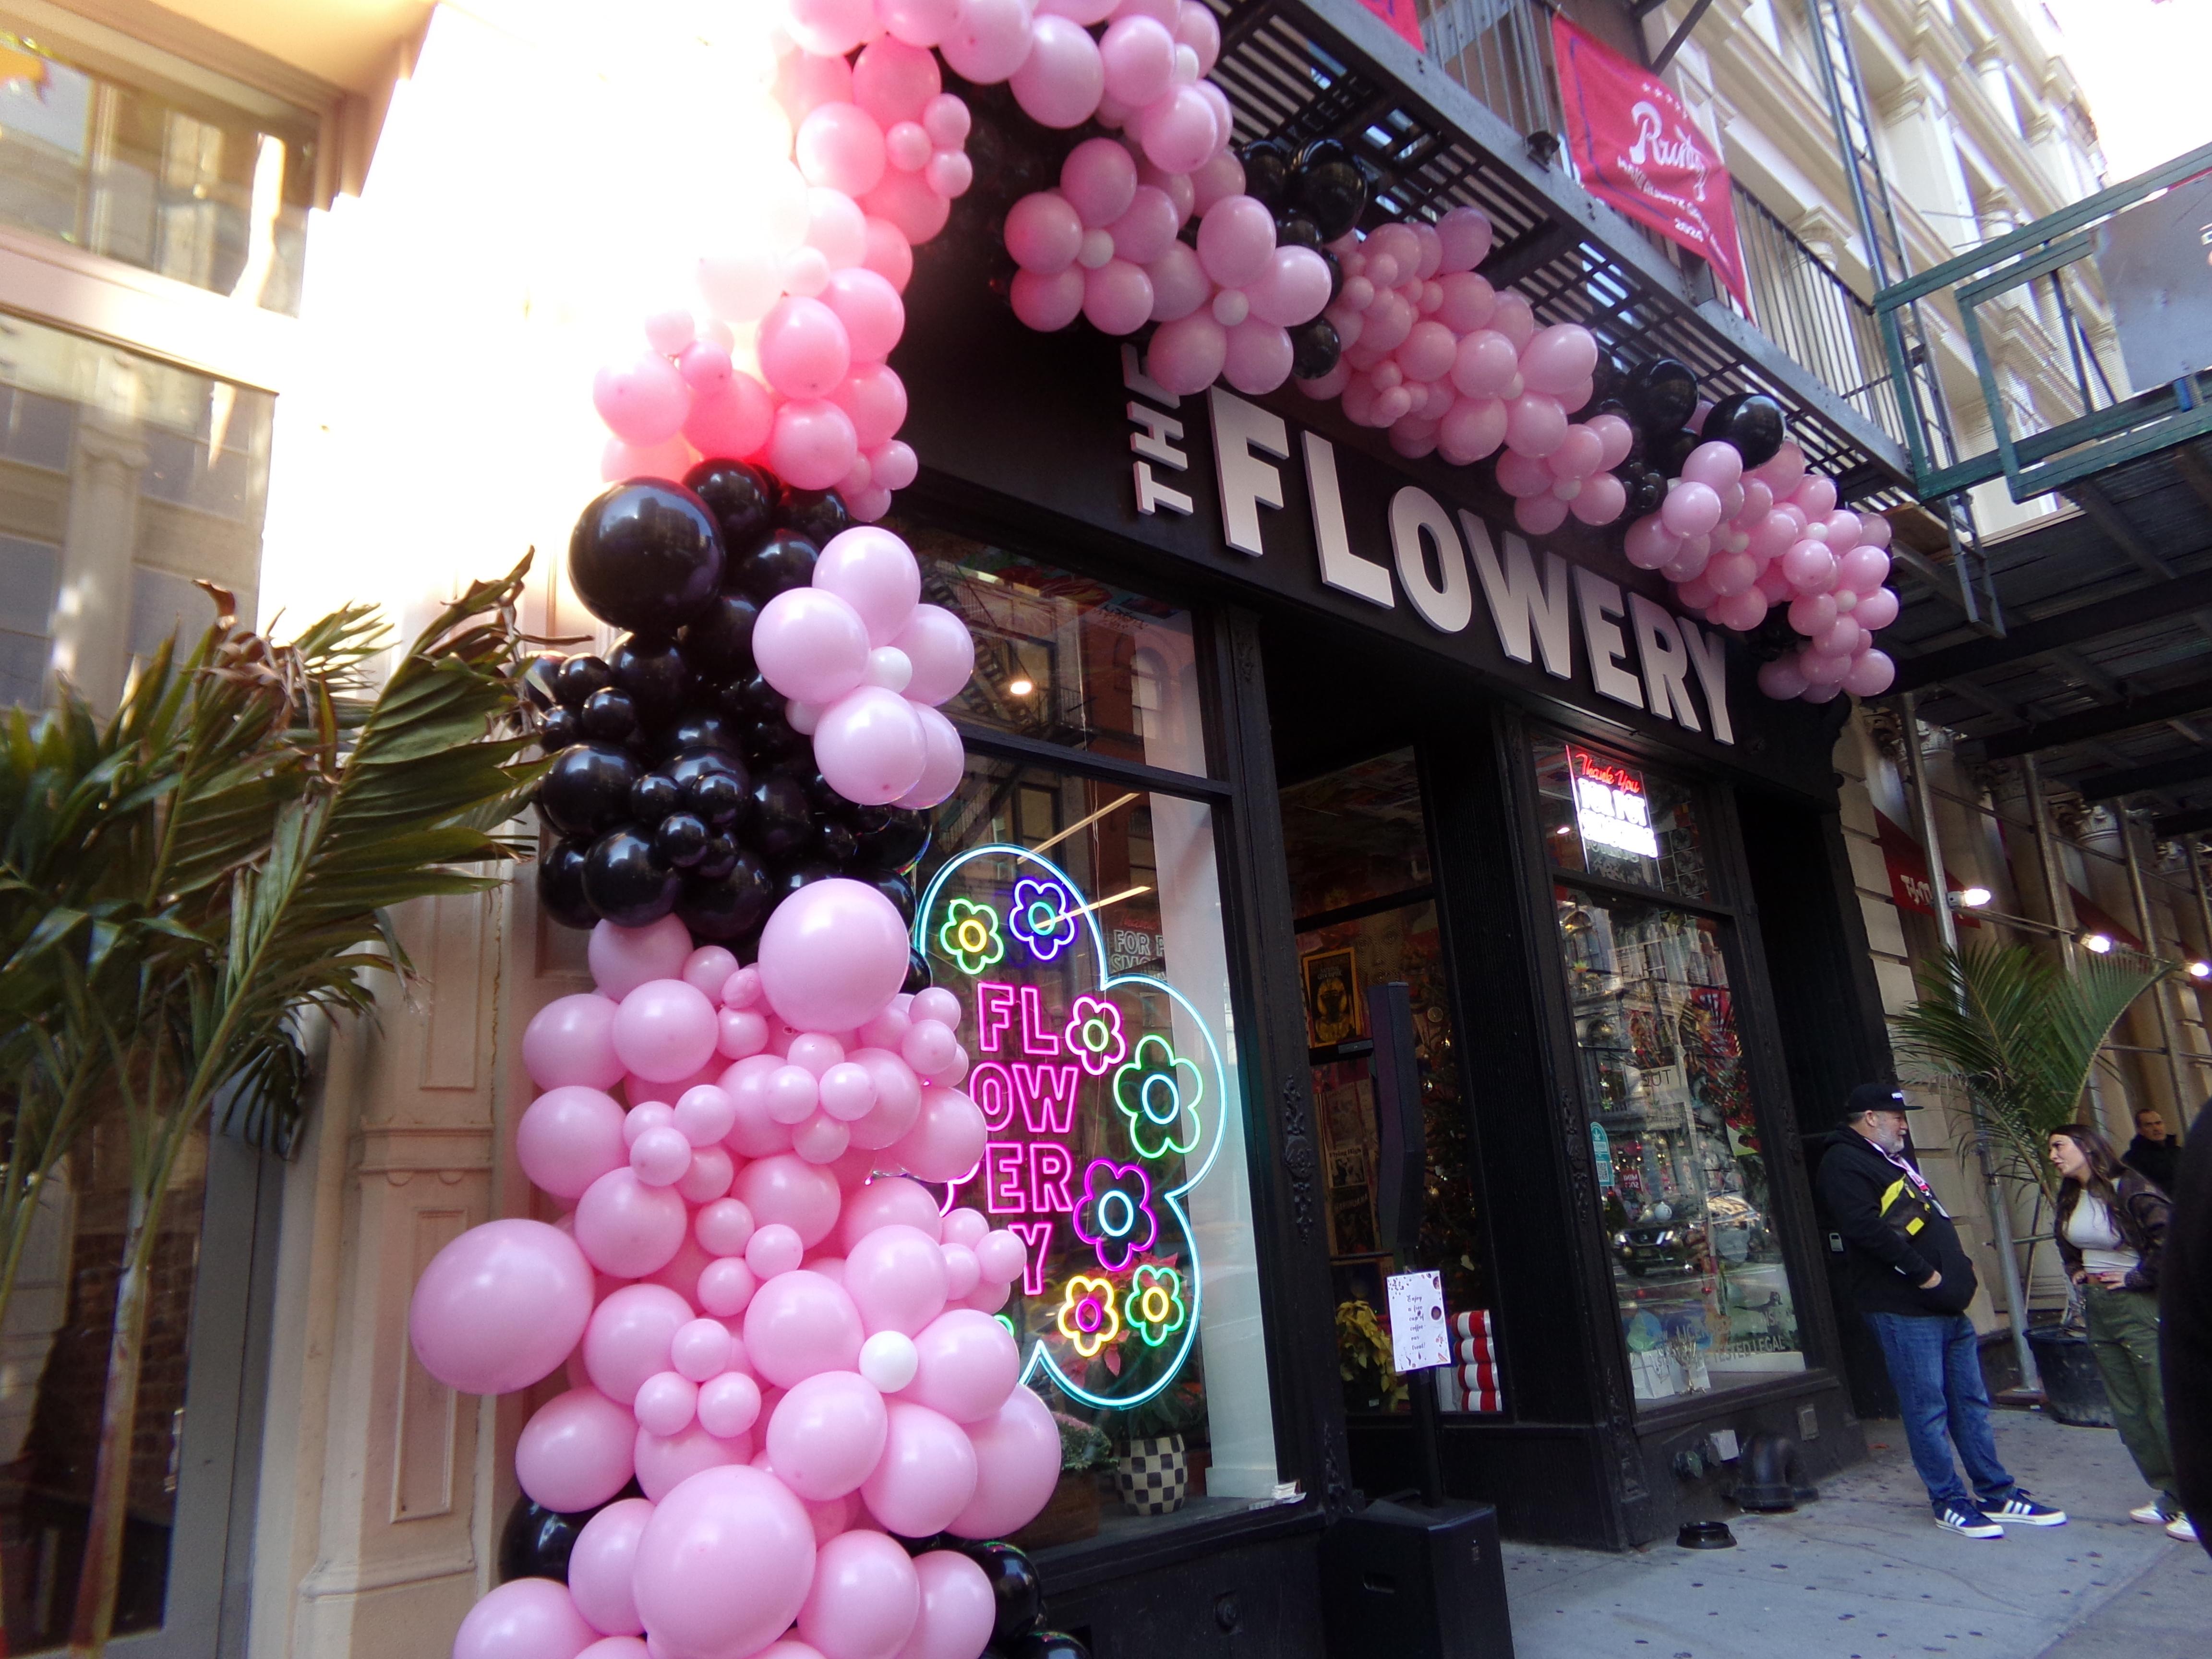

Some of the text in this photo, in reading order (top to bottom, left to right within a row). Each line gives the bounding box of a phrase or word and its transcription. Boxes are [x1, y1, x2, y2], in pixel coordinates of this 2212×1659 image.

[1205, 384, 1734, 745] FLOWERY
[1575, 753, 1640, 794] Thank You
[1113, 929, 1151, 956] FOR
[1407, 1295, 1422, 1303] Enjoy
[1414, 1305, 1423, 1313] free
[1412, 1342, 1426, 1350] treat!
